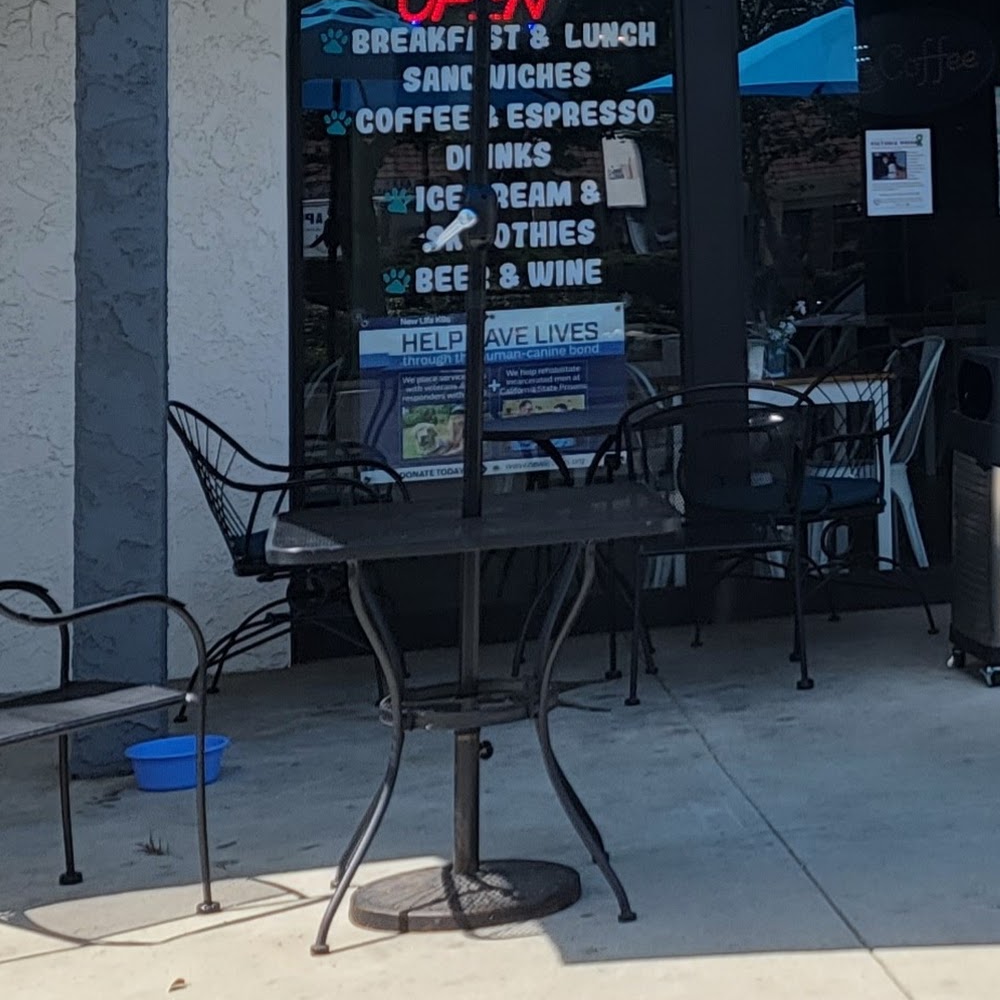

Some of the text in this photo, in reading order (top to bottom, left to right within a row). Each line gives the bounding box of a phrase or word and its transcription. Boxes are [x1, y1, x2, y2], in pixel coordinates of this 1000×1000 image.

[529, 23, 550, 50] &
[564, 20, 656, 48] LUNCH
[355, 104, 471, 134] COFFEE
[506, 98, 655, 130] ESPRESSO
[415, 179, 601, 212] ICE REAM &
[425, 219, 596, 251] SOTHIES
[415, 258, 603, 294] BEE & WINE
[402, 321, 599, 353] HELP AVE LIVES
[402, 352, 452, 367] through
[486, 346, 566, 361] uman-canine
[569, 344, 600, 356] bond
